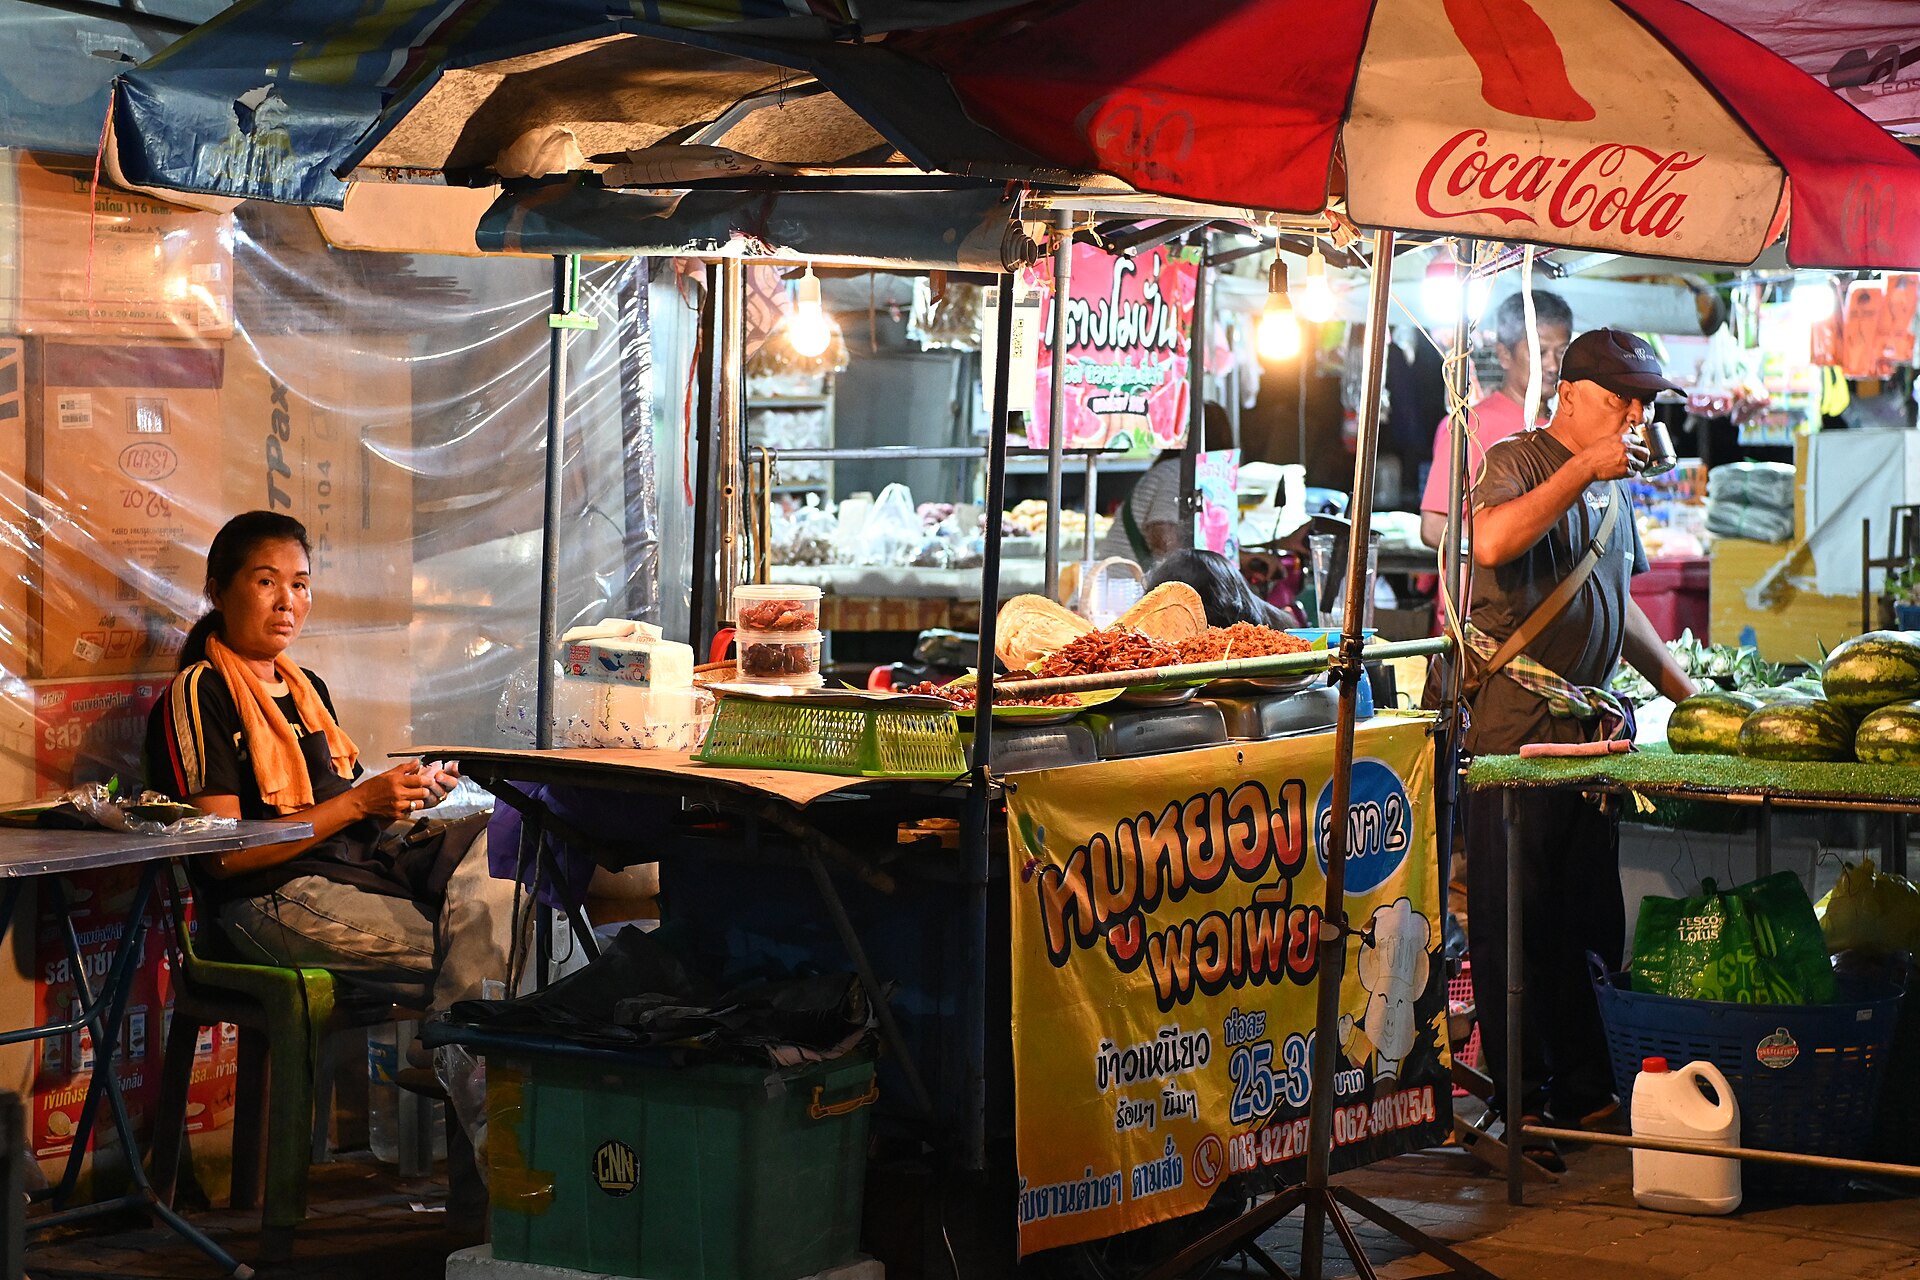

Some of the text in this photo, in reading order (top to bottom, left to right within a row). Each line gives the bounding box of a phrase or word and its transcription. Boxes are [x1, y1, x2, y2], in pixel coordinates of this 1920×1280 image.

[127, 202, 147, 214] 116
[1415, 129, 1707, 238] Coca-Cola
[267, 374, 291, 510] TPax
[1383, 792, 1406, 852] 2
[1039, 780, 1306, 967] หมูหยอง
[1147, 878, 1340, 1010] พอเพีย
[1679, 915, 1719, 926] TESCO
[1224, 1008, 1266, 1046] ห่อละ
[1096, 1025, 1211, 1091] ข้าวเหนียว
[1334, 1068, 1366, 1095] บาท
[1115, 1099, 1156, 1131] ร้อนๆ
[1334, 1085, 1436, 1146] 062-3981254
[597, 1142, 635, 1182] CNN
[1131, 1135, 1183, 1199] ตามสั่ง
